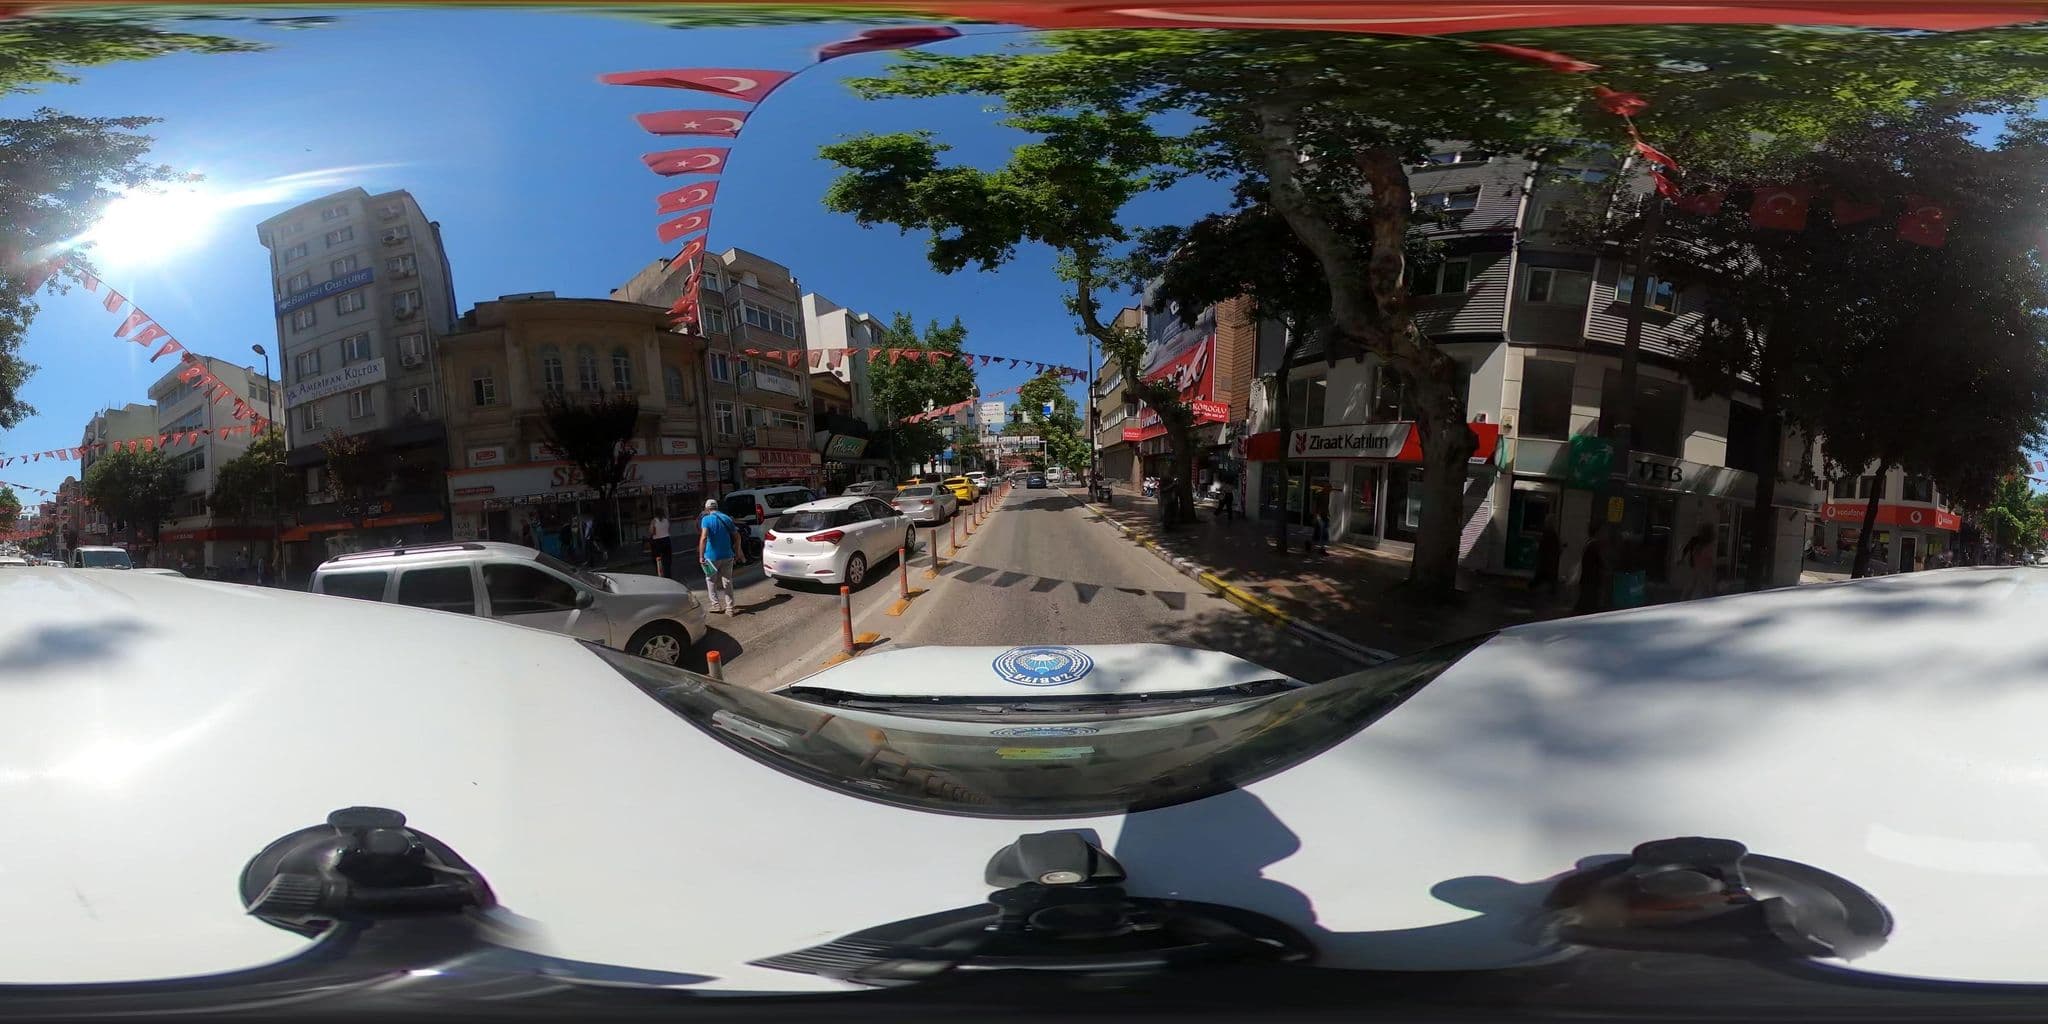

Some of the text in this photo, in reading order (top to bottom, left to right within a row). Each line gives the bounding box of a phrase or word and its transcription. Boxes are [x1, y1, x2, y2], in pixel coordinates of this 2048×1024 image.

[1309, 433, 1388, 449] Ziraat Katılım
[1635, 460, 1683, 482] TEB
[1837, 509, 1865, 517] vodafone
[1014, 673, 1073, 684] ZABITA
